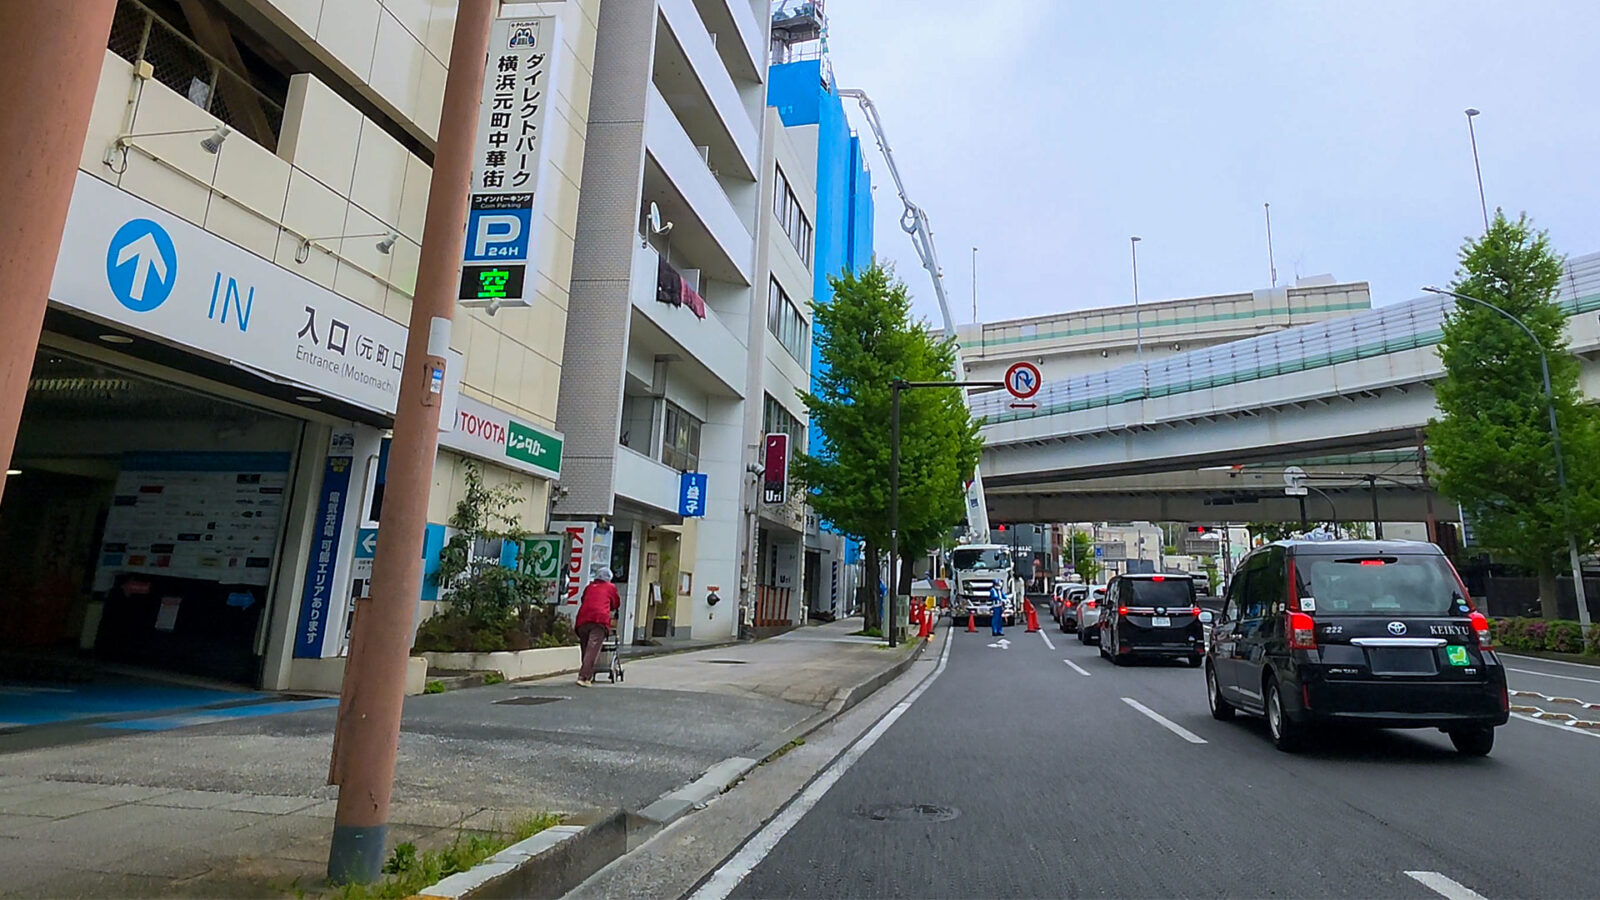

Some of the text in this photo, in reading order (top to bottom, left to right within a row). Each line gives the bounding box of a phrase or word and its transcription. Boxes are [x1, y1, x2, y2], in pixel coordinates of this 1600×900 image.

[483, 55, 518, 188] 横浜元町中華街
[512, 53, 545, 187] ダイレクトパーク
[475, 195, 531, 203] コインパーキング
[474, 215, 521, 256] P
[488, 246, 519, 256] 24H
[478, 268, 509, 298] 空
[208, 272, 254, 331] IN
[298, 305, 349, 356] 入口
[296, 344, 339, 374] Entrance
[461, 411, 505, 445] TOYOTA
[508, 432, 546, 456] レンタカー
[765, 490, 782, 502] Uri
[1429, 625, 1470, 636] KEIKYU
